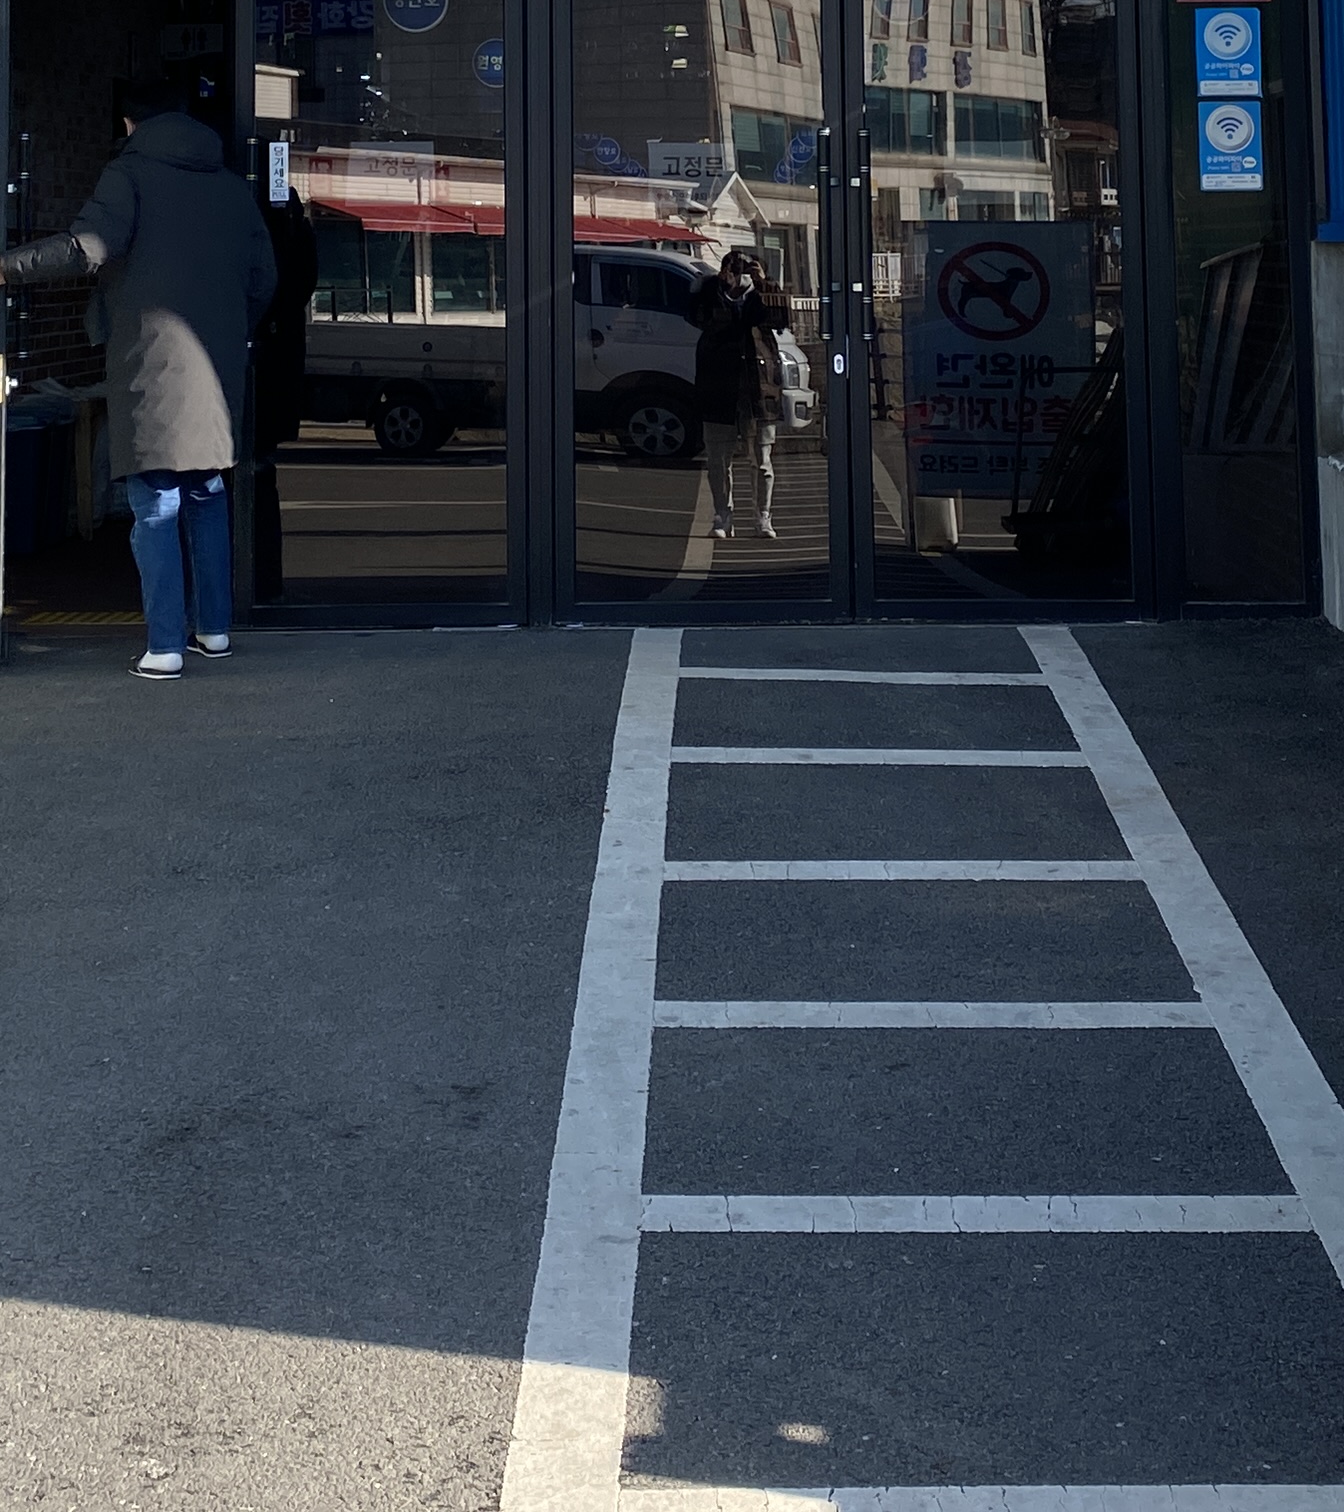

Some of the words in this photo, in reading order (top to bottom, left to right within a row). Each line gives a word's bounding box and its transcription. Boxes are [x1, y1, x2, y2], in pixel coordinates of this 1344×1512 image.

[273, 146, 285, 188] 당기세요
[363, 156, 419, 177] 고정문
[662, 155, 724, 177] 고정문
